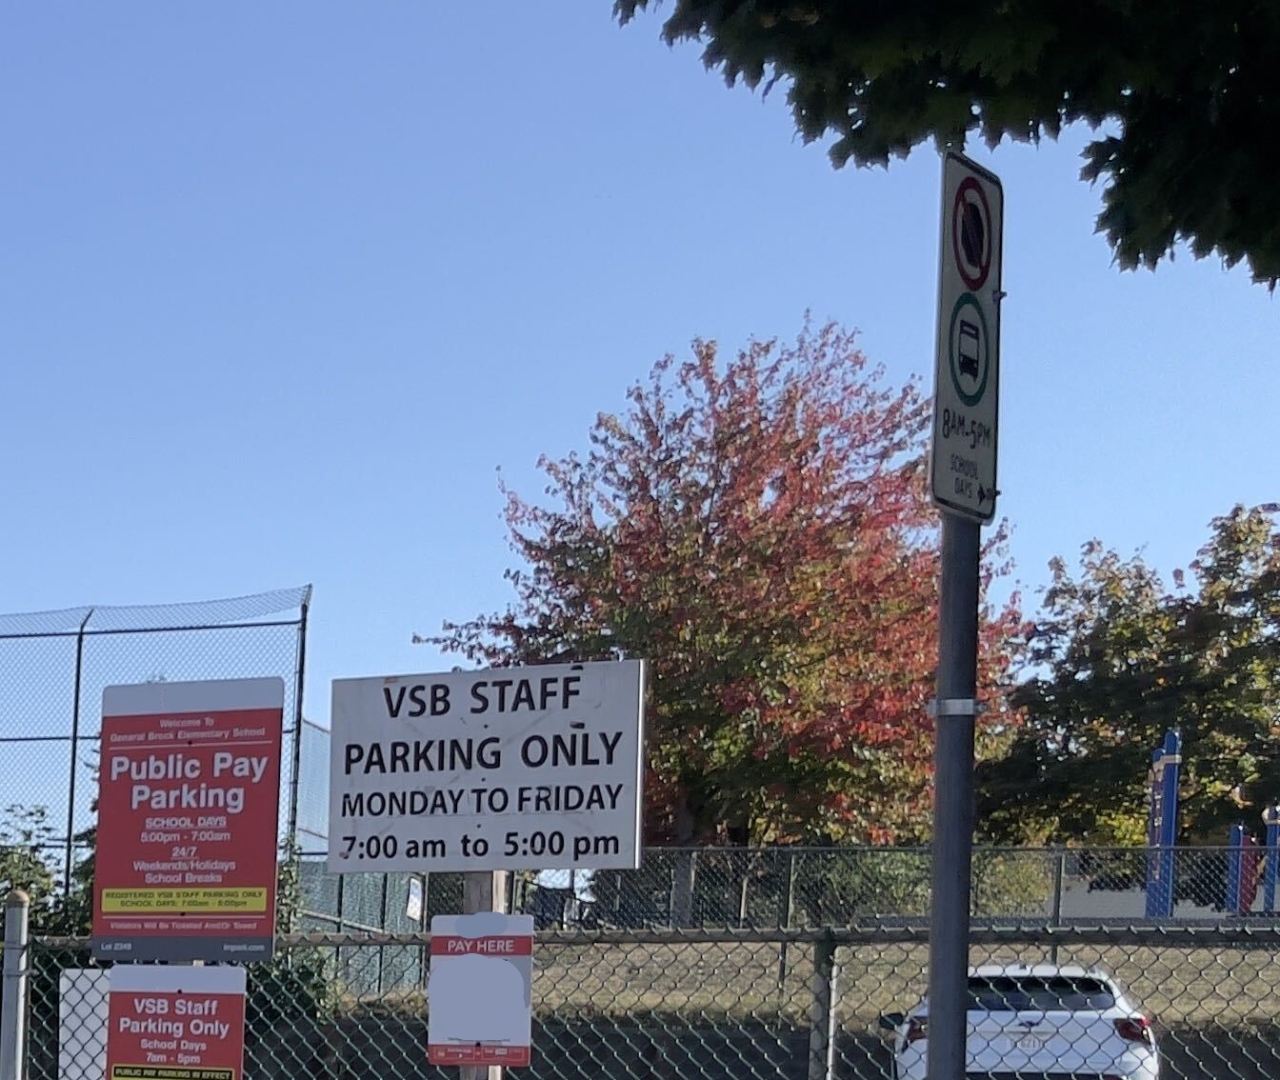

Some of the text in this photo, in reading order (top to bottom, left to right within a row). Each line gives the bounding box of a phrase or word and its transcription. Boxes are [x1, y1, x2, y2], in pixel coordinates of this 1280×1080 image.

[942, 408, 991, 449] 8AM-5PM
[383, 675, 581, 719] VSB STAFF
[160, 717, 214, 728] Welcome To
[110, 728, 265, 742] General Brock Elementary School
[344, 731, 623, 775] PARKING ONLY
[111, 752, 269, 783] Public Pay
[131, 783, 245, 814] Parking
[341, 783, 623, 818] MONDAY TO FRIDAY
[145, 816, 227, 828] SCHOOL DAYS
[140, 832, 180, 843] 5:00pm
[191, 831, 230, 842] 7:00am
[172, 846, 197, 858] 24/7
[341, 830, 619, 861] 7:00 am to 5:00 pm
[133, 860, 236, 872] Weekends/Holidays
[145, 872, 222, 884] School Breaks
[448, 940, 514, 952] PAY HERE
[134, 998, 218, 1016] VSB Staff
[119, 1018, 230, 1040] Parking Only
[140, 1039, 207, 1053] School Days
[146, 1052, 167, 1063] 7am
[178, 1054, 200, 1064] 5pm
[115, 1068, 141, 1076] PUBLIC
[158, 1070, 190, 1078] PARKING
[202, 1072, 230, 1080] EFFECT
